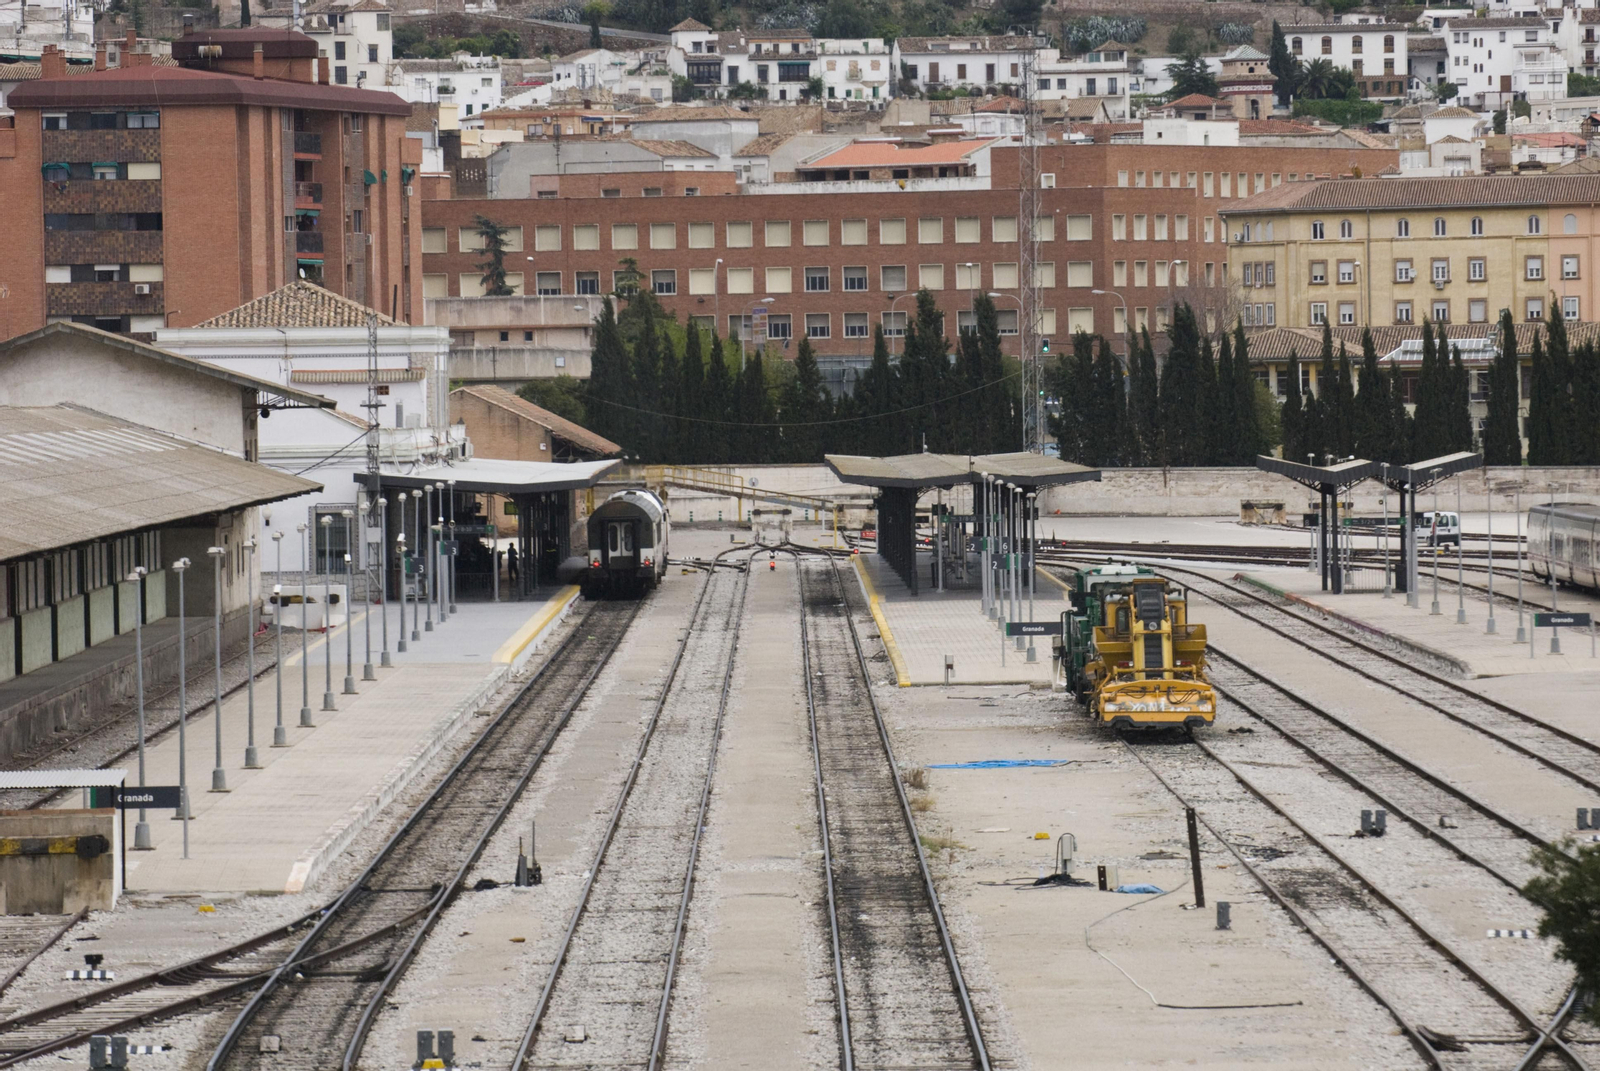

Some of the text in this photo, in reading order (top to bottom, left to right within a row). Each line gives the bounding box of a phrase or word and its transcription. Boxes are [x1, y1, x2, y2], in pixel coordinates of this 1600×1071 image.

[970, 543, 976, 551] 2
[1002, 542, 1008, 550] 6
[452, 547, 457, 555] 3
[418, 564, 424, 573] 3
[992, 560, 998, 569] 2
[117, 793, 154, 802] Granada
